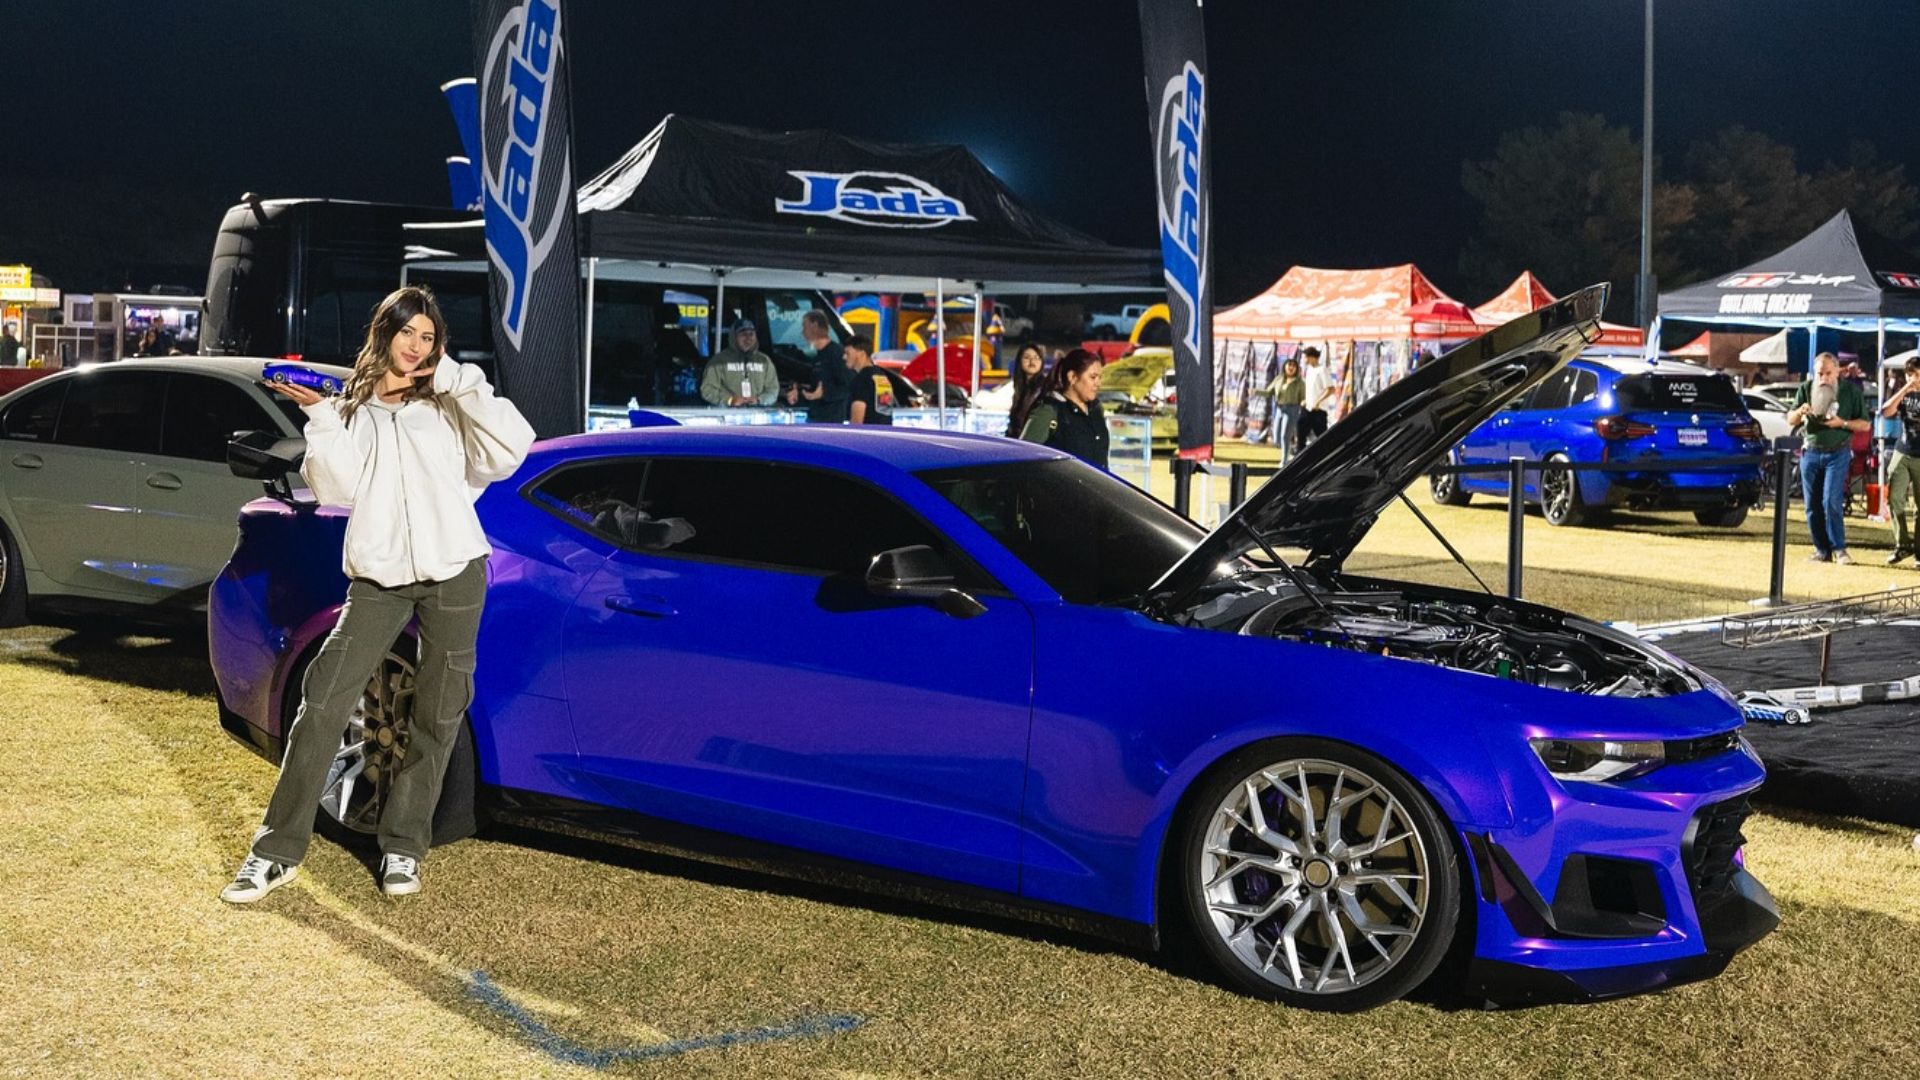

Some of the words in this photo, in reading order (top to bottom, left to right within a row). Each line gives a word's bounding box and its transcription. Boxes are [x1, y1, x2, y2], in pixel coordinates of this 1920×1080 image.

[484, 0, 562, 352] Jada
[775, 170, 978, 224] Jada
[1160, 60, 1205, 361] Jada
[1718, 293, 1768, 314] BUILDING
[1765, 293, 1813, 314] DREAMS
